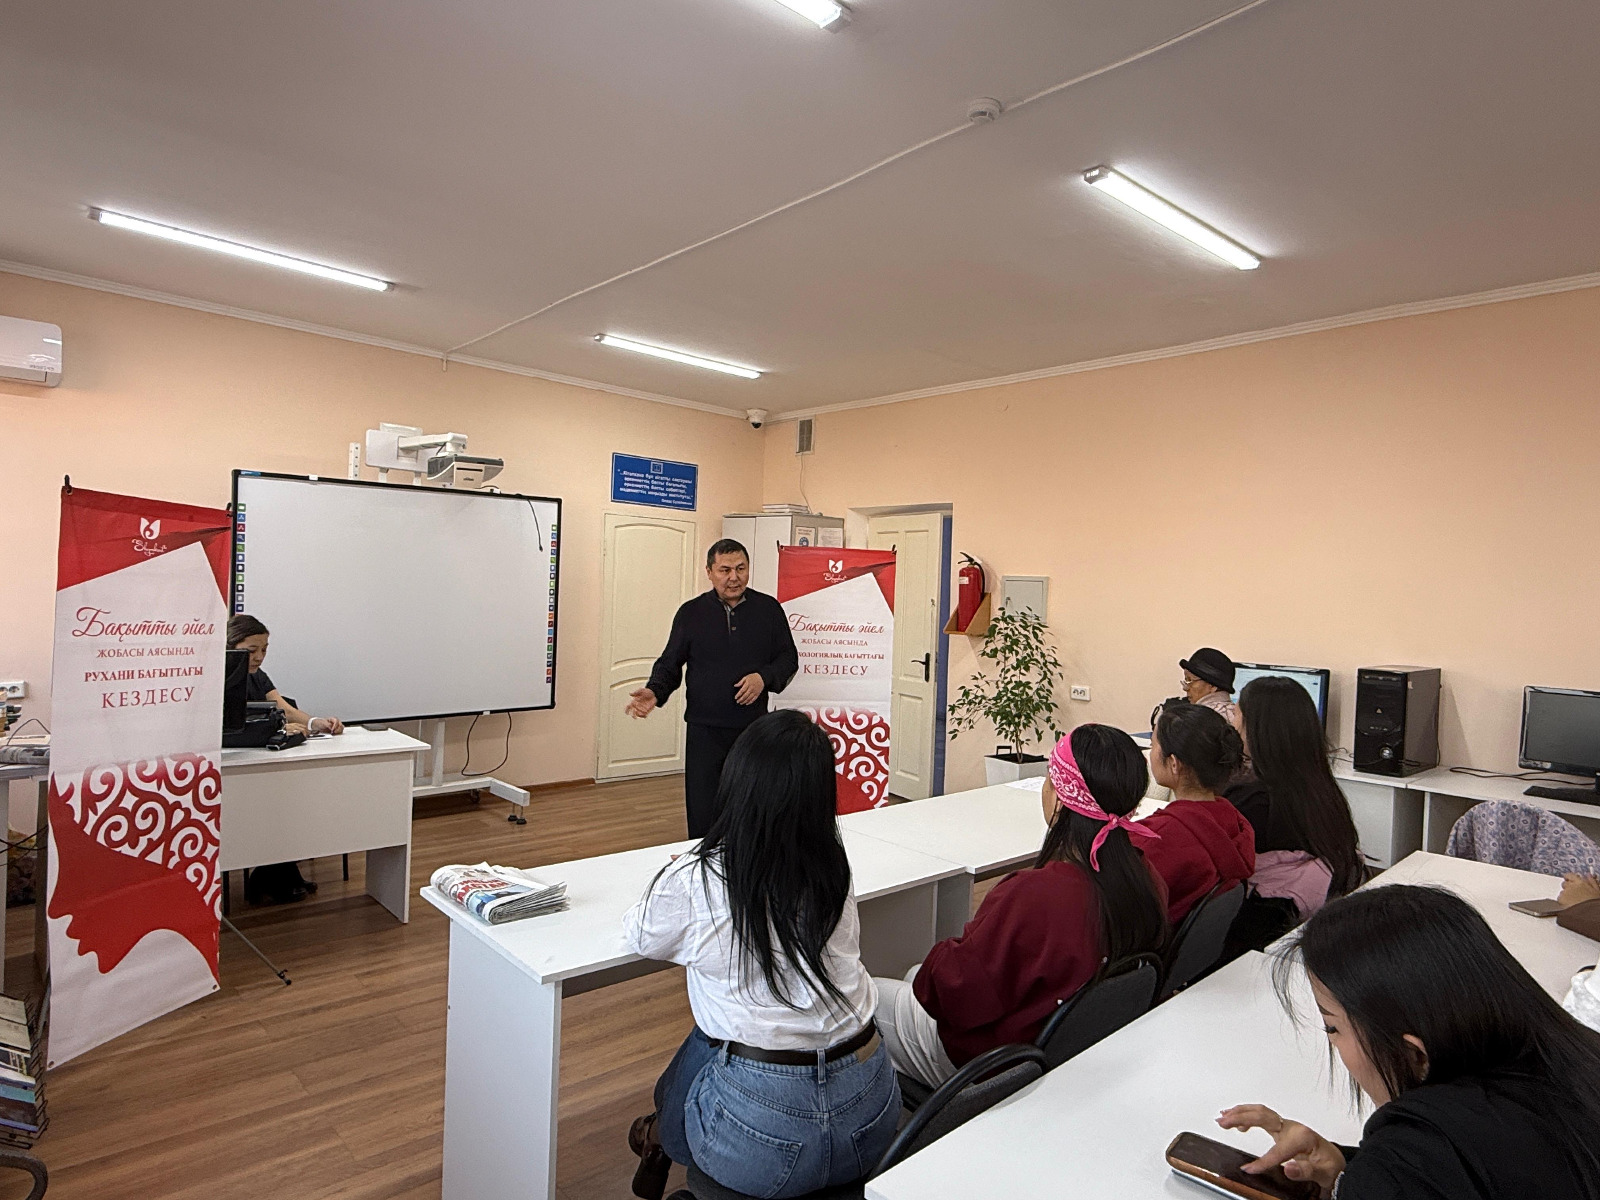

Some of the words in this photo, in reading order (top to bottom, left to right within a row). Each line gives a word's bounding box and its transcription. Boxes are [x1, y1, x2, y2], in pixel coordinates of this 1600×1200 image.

[72, 607, 177, 642] Бақытты
[788, 613, 854, 635] Бақытты
[833, 639, 868, 647] АЯСЫНДА
[96, 648, 145, 659] ЖОБАСЫ
[147, 647, 195, 657] АЯСЫНДА
[84, 669, 135, 682] РУХАНИ
[138, 666, 203, 679] БАҒЫТТАҒЫ
[803, 664, 869, 676] КЕЗДЕСУ
[101, 686, 195, 709] КЕЗДЕСУ
